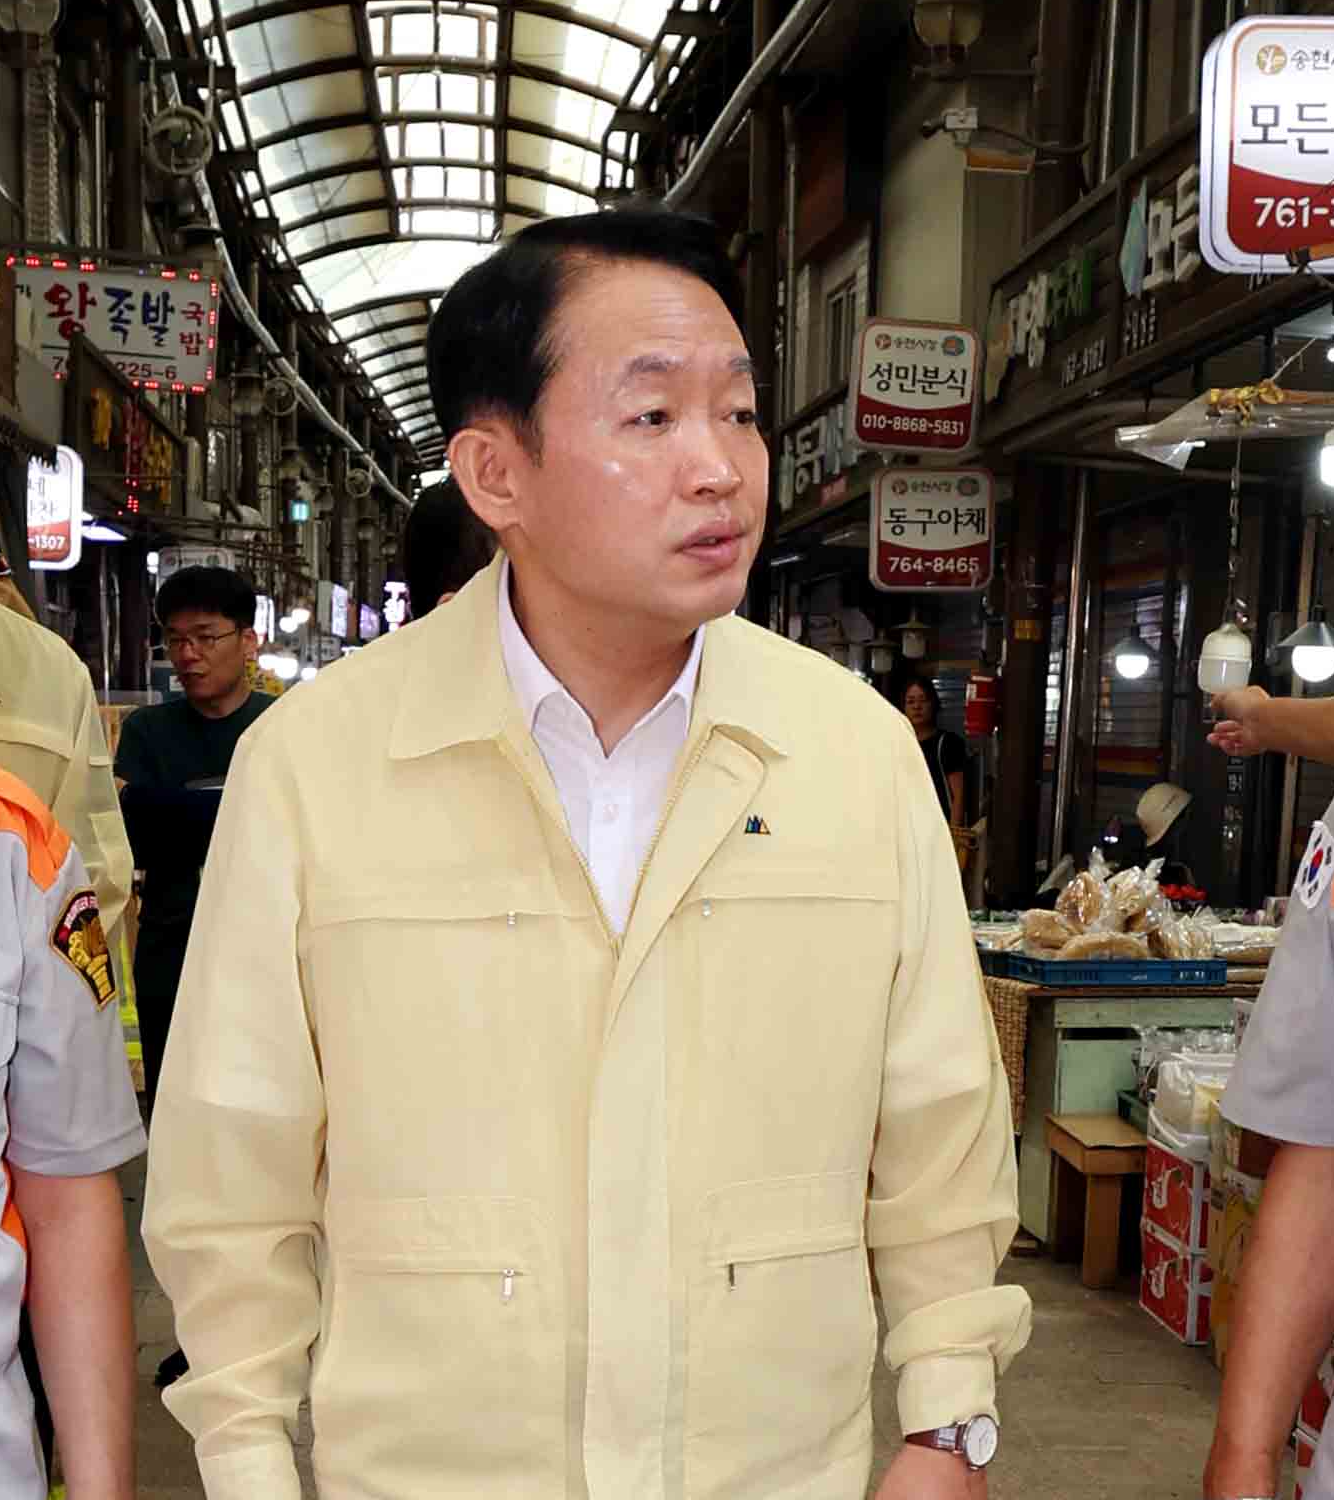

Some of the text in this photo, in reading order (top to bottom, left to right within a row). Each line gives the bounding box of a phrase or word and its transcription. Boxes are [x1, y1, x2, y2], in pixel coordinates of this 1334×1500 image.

[179, 301, 205, 357] 국밥
[868, 360, 967, 398] 성민분식
[861, 412, 965, 437] 010-8868-5831
[884, 506, 987, 536] 동구야채
